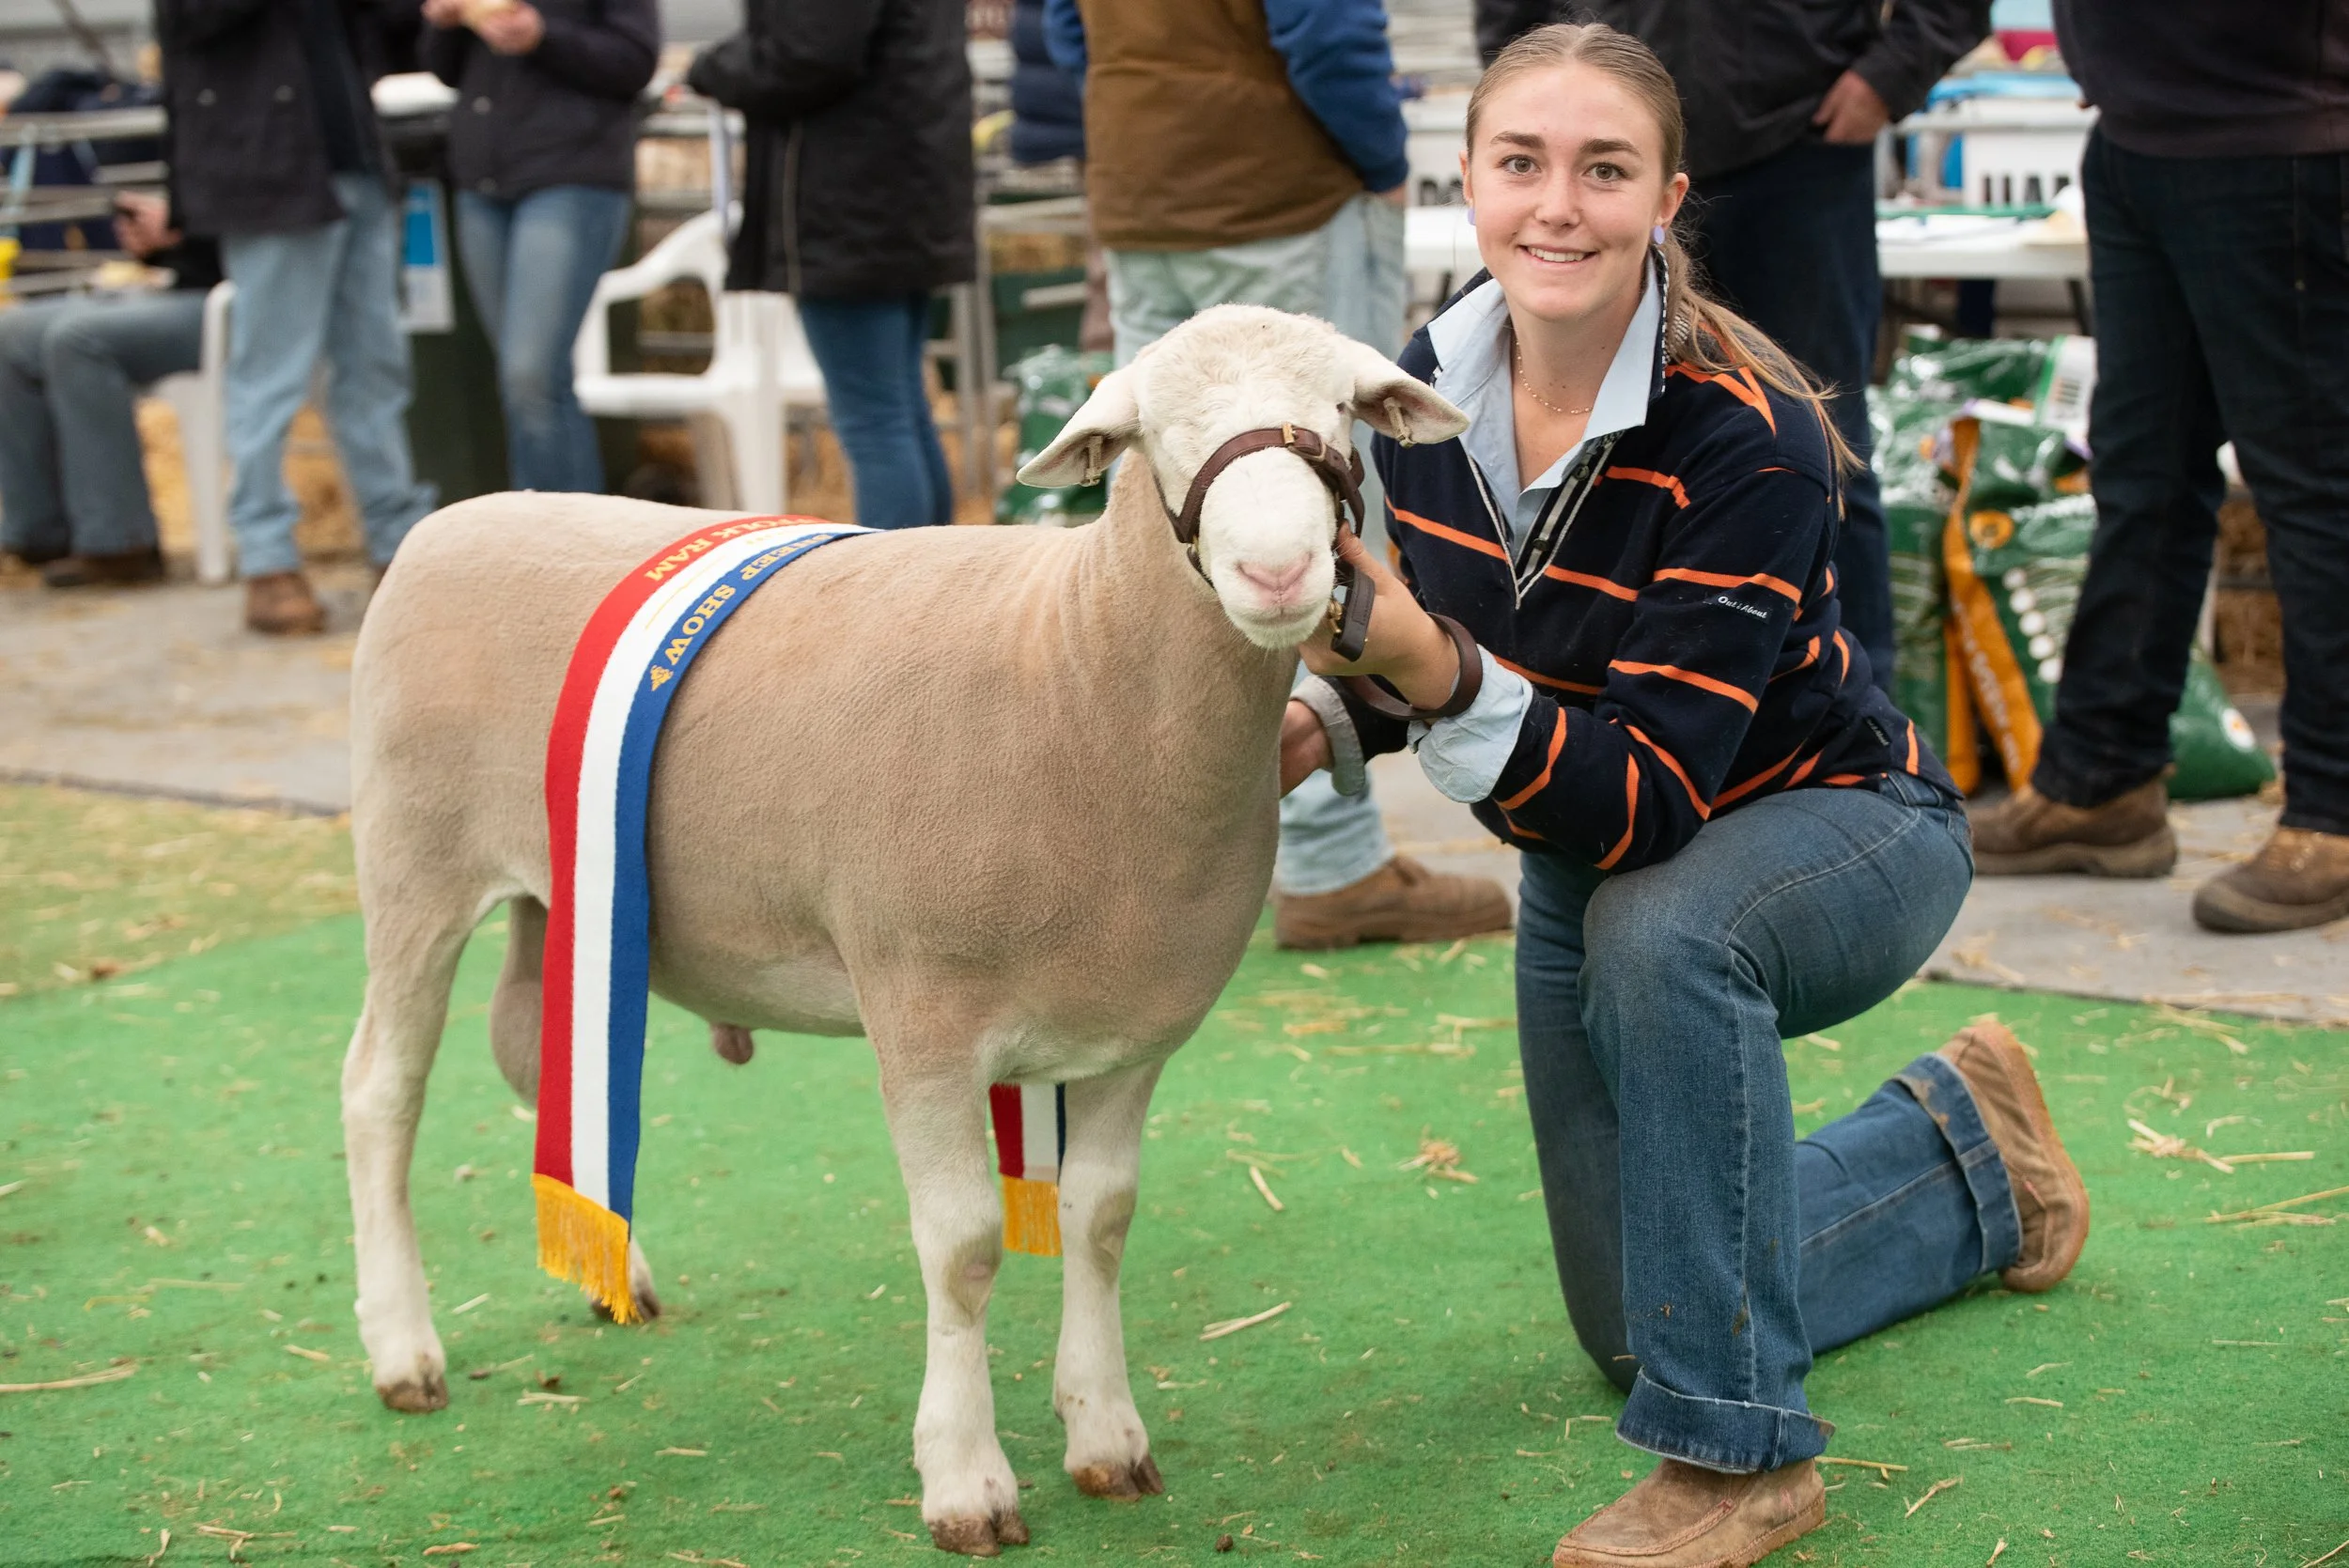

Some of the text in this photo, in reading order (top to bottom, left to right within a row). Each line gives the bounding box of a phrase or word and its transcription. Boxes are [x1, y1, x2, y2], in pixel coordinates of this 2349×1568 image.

[645, 537, 713, 582] RAM
[664, 584, 736, 665] SHOW
[1718, 596, 1737, 607] Out
[1741, 605, 1767, 618] About
